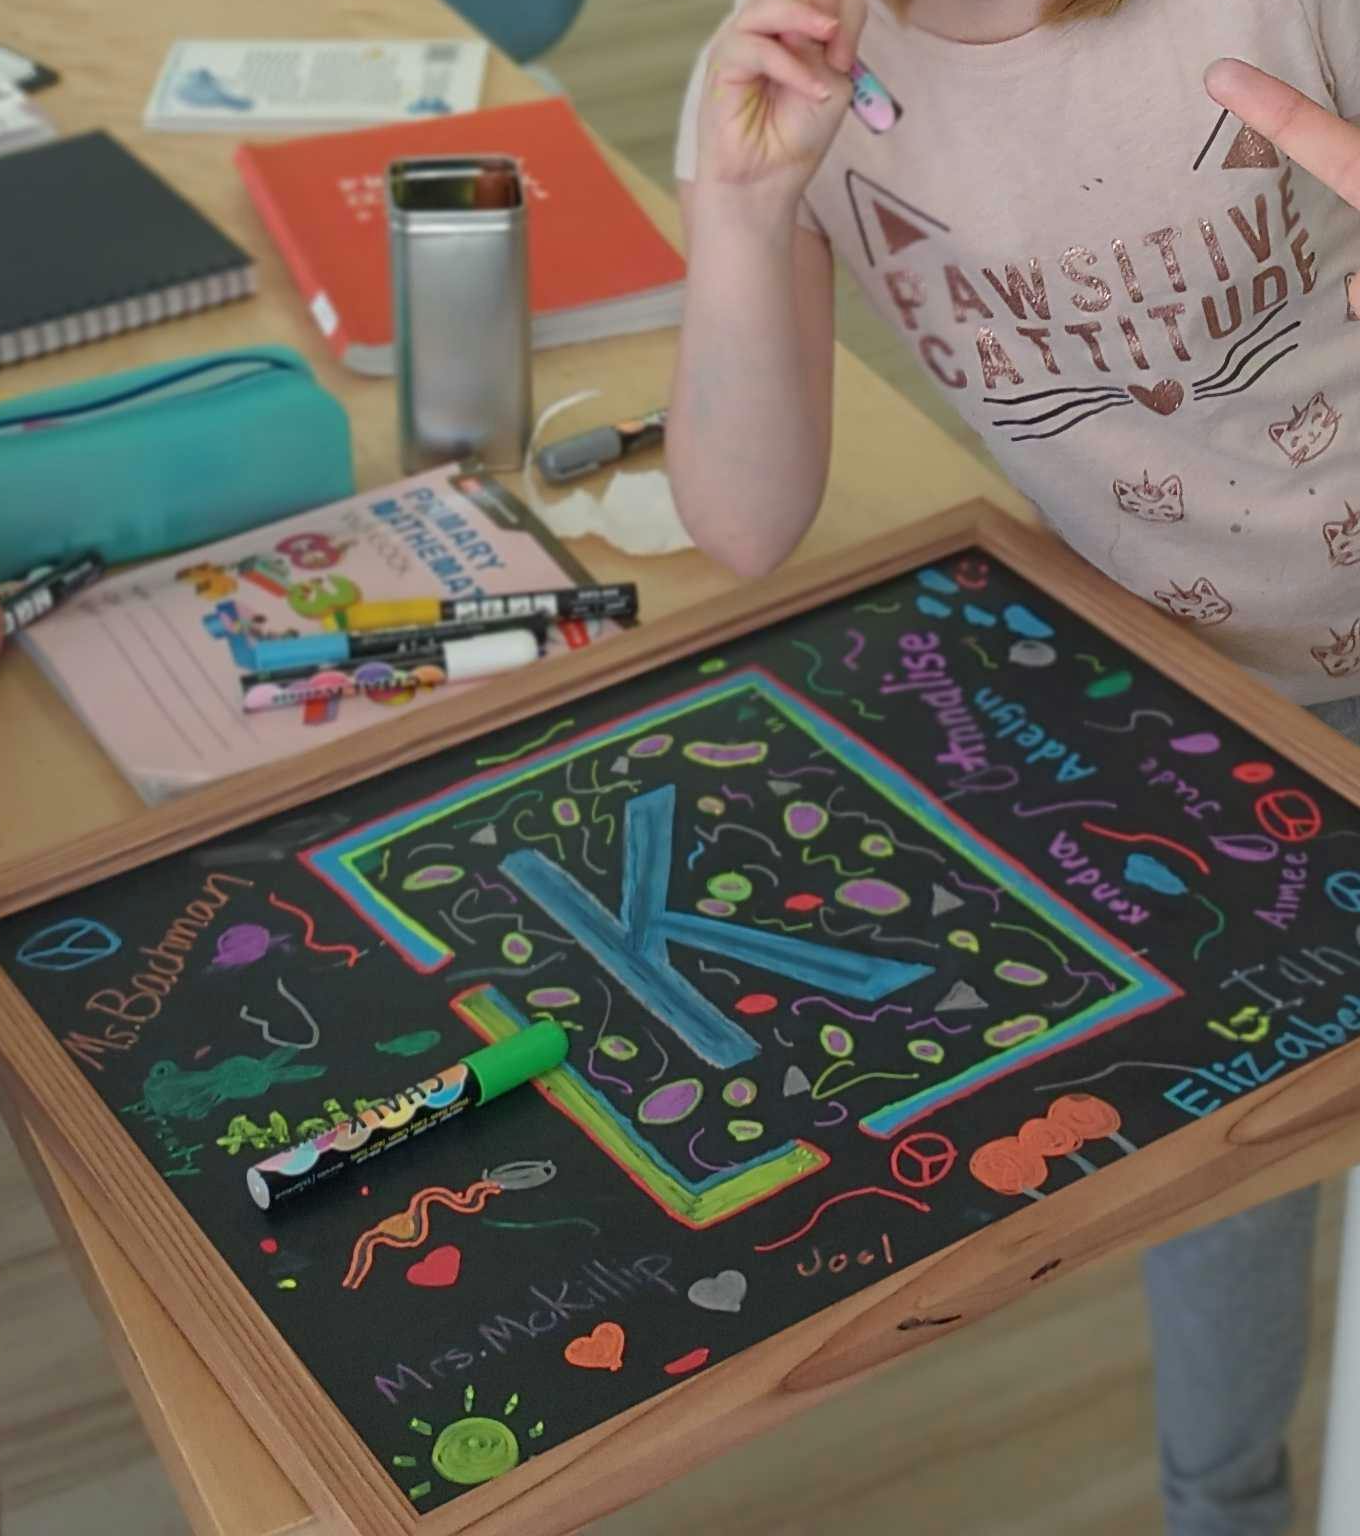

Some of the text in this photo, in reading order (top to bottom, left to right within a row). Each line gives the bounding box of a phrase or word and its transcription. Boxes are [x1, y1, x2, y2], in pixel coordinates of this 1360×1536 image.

[885, 166, 1301, 331] PAWSITIVE
[918, 228, 1318, 389] CATTITUDE
[403, 487, 506, 570] PRIMARY
[85, 872, 255, 1022] Bachman
[498, 783, 936, 1070] K
[374, 1347, 488, 1405] Mrs.
